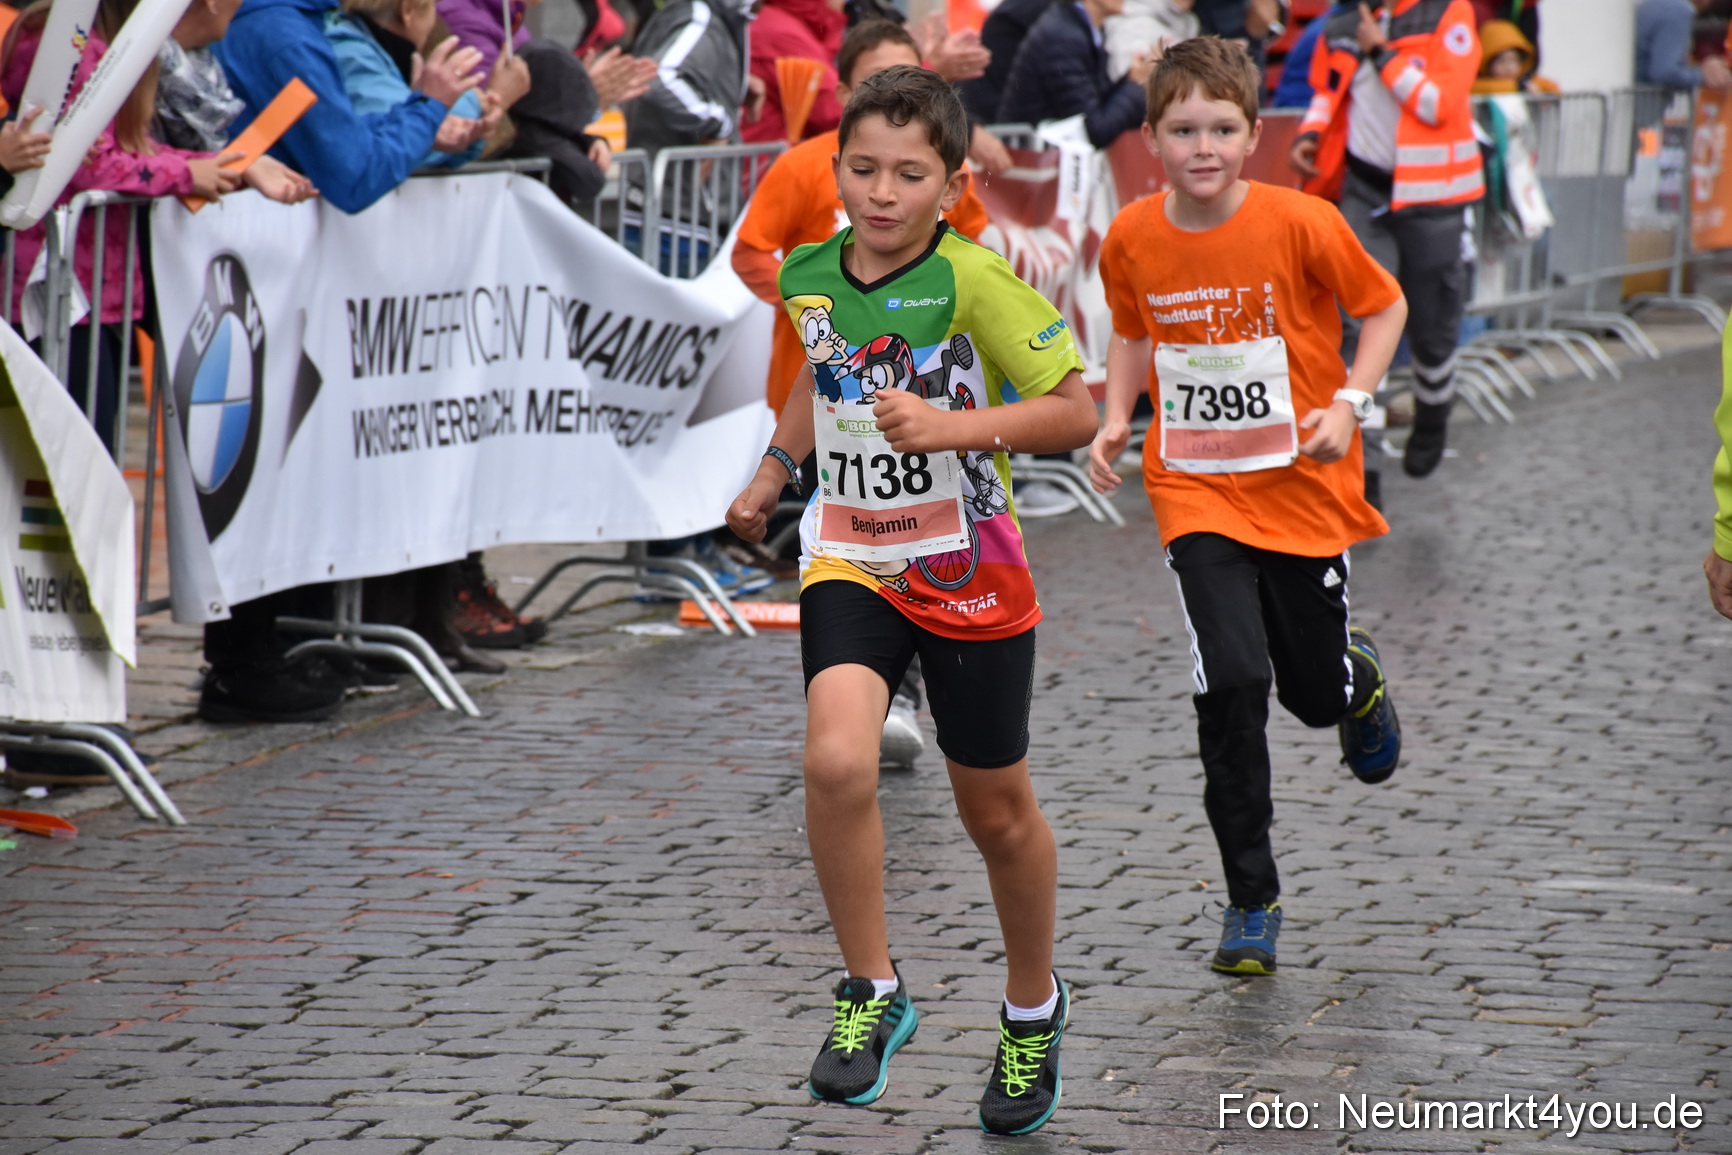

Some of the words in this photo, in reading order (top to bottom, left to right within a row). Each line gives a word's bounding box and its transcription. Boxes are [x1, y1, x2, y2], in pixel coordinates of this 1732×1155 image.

[1146, 287, 1230, 307] Neumarkter
[1176, 381, 1271, 422] 7398
[829, 451, 933, 500] 7138
[851, 515, 918, 538] Benjamin
